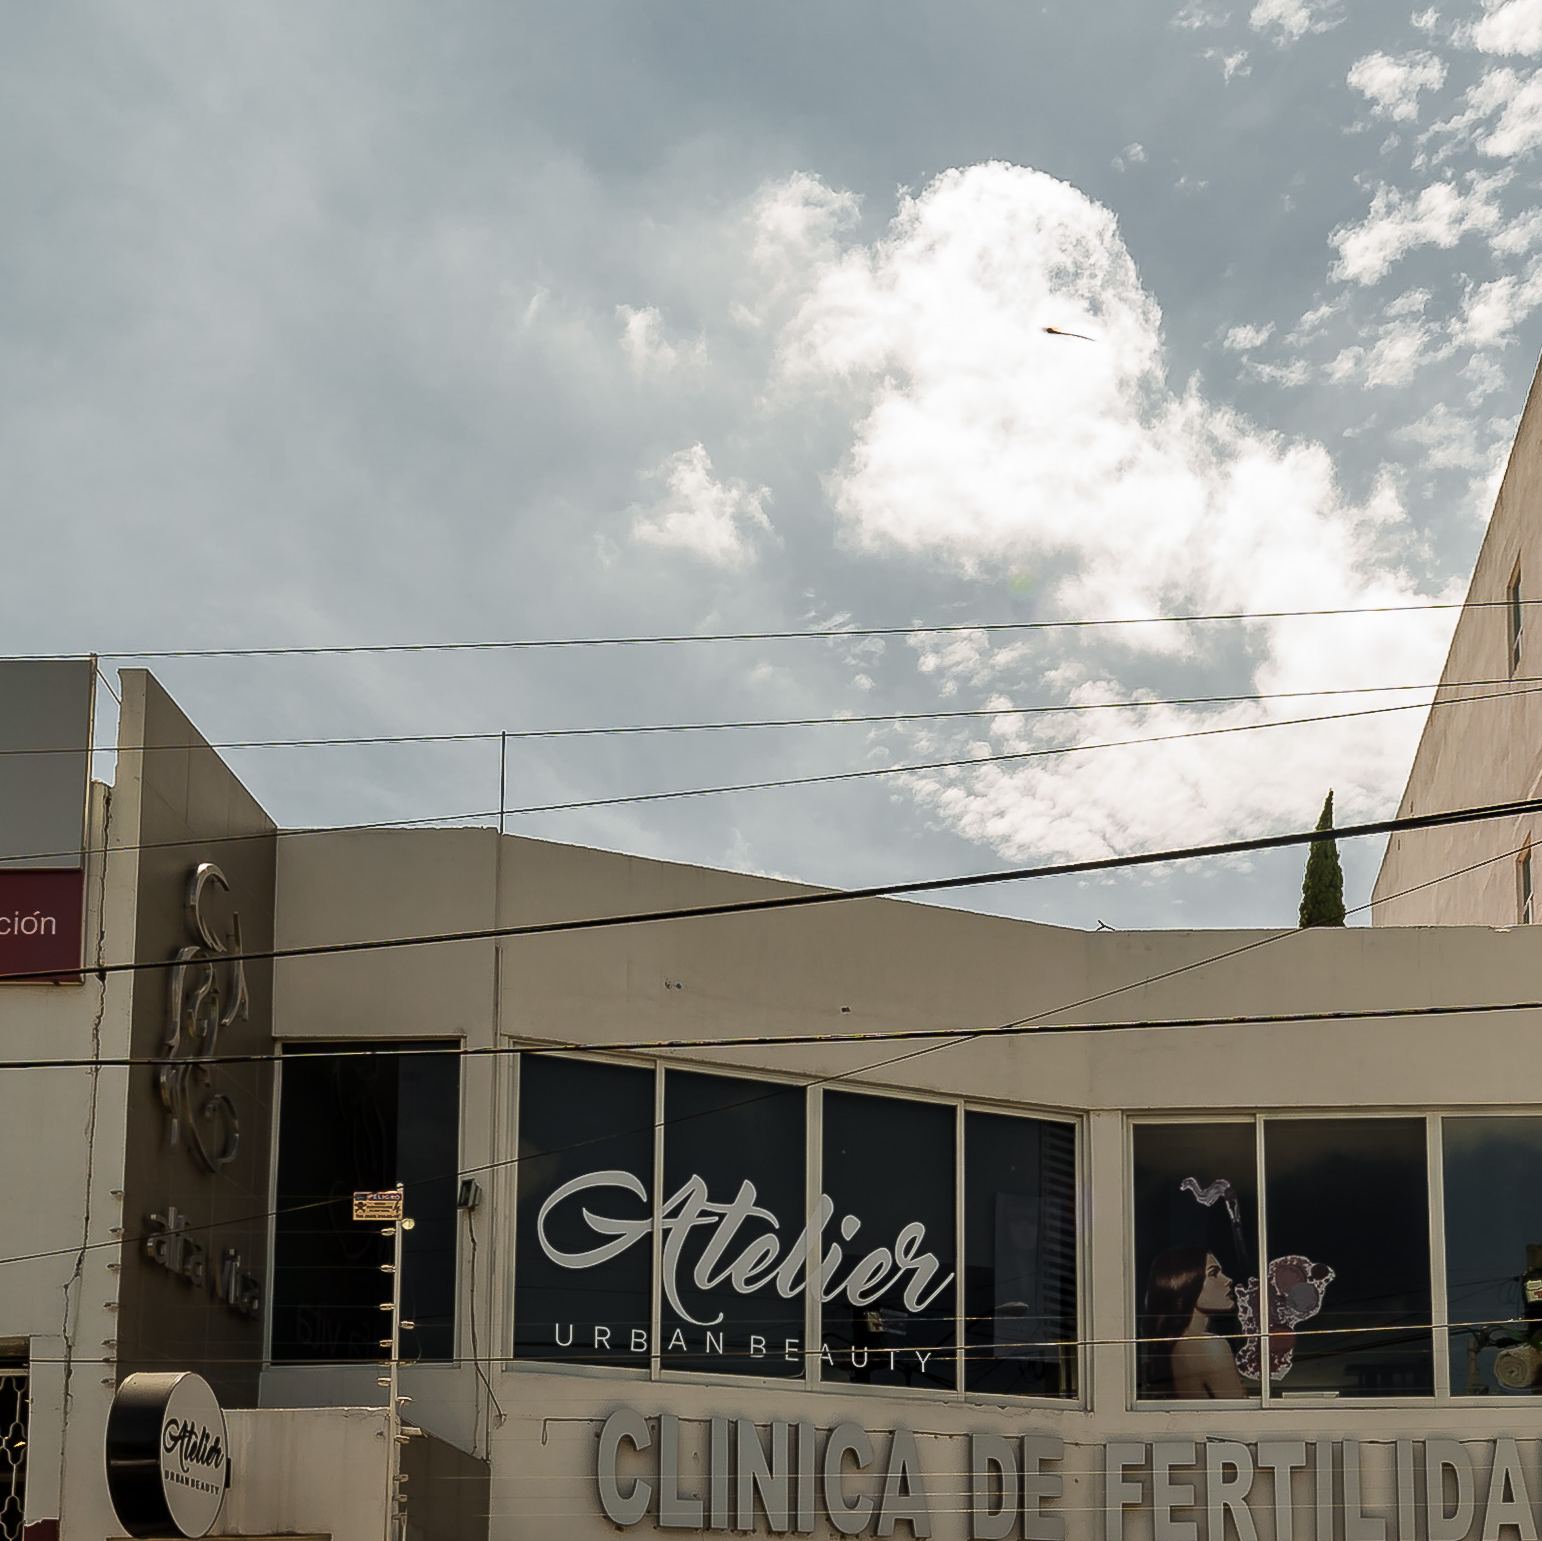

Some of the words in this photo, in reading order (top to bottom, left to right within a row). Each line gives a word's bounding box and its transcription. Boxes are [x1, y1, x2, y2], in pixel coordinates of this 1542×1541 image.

[537, 1170, 954, 1325] Atelier
[554, 1323, 724, 1355] URBAN
[750, 1335, 932, 1373] BEAUTY
[163, 1418, 224, 1473] Atelier
[164, 1470, 190, 1486] URBAN
[190, 1474, 220, 1495] BEAUTY
[597, 1408, 931, 1538] CLINICA
[970, 1434, 1065, 1541] DE
